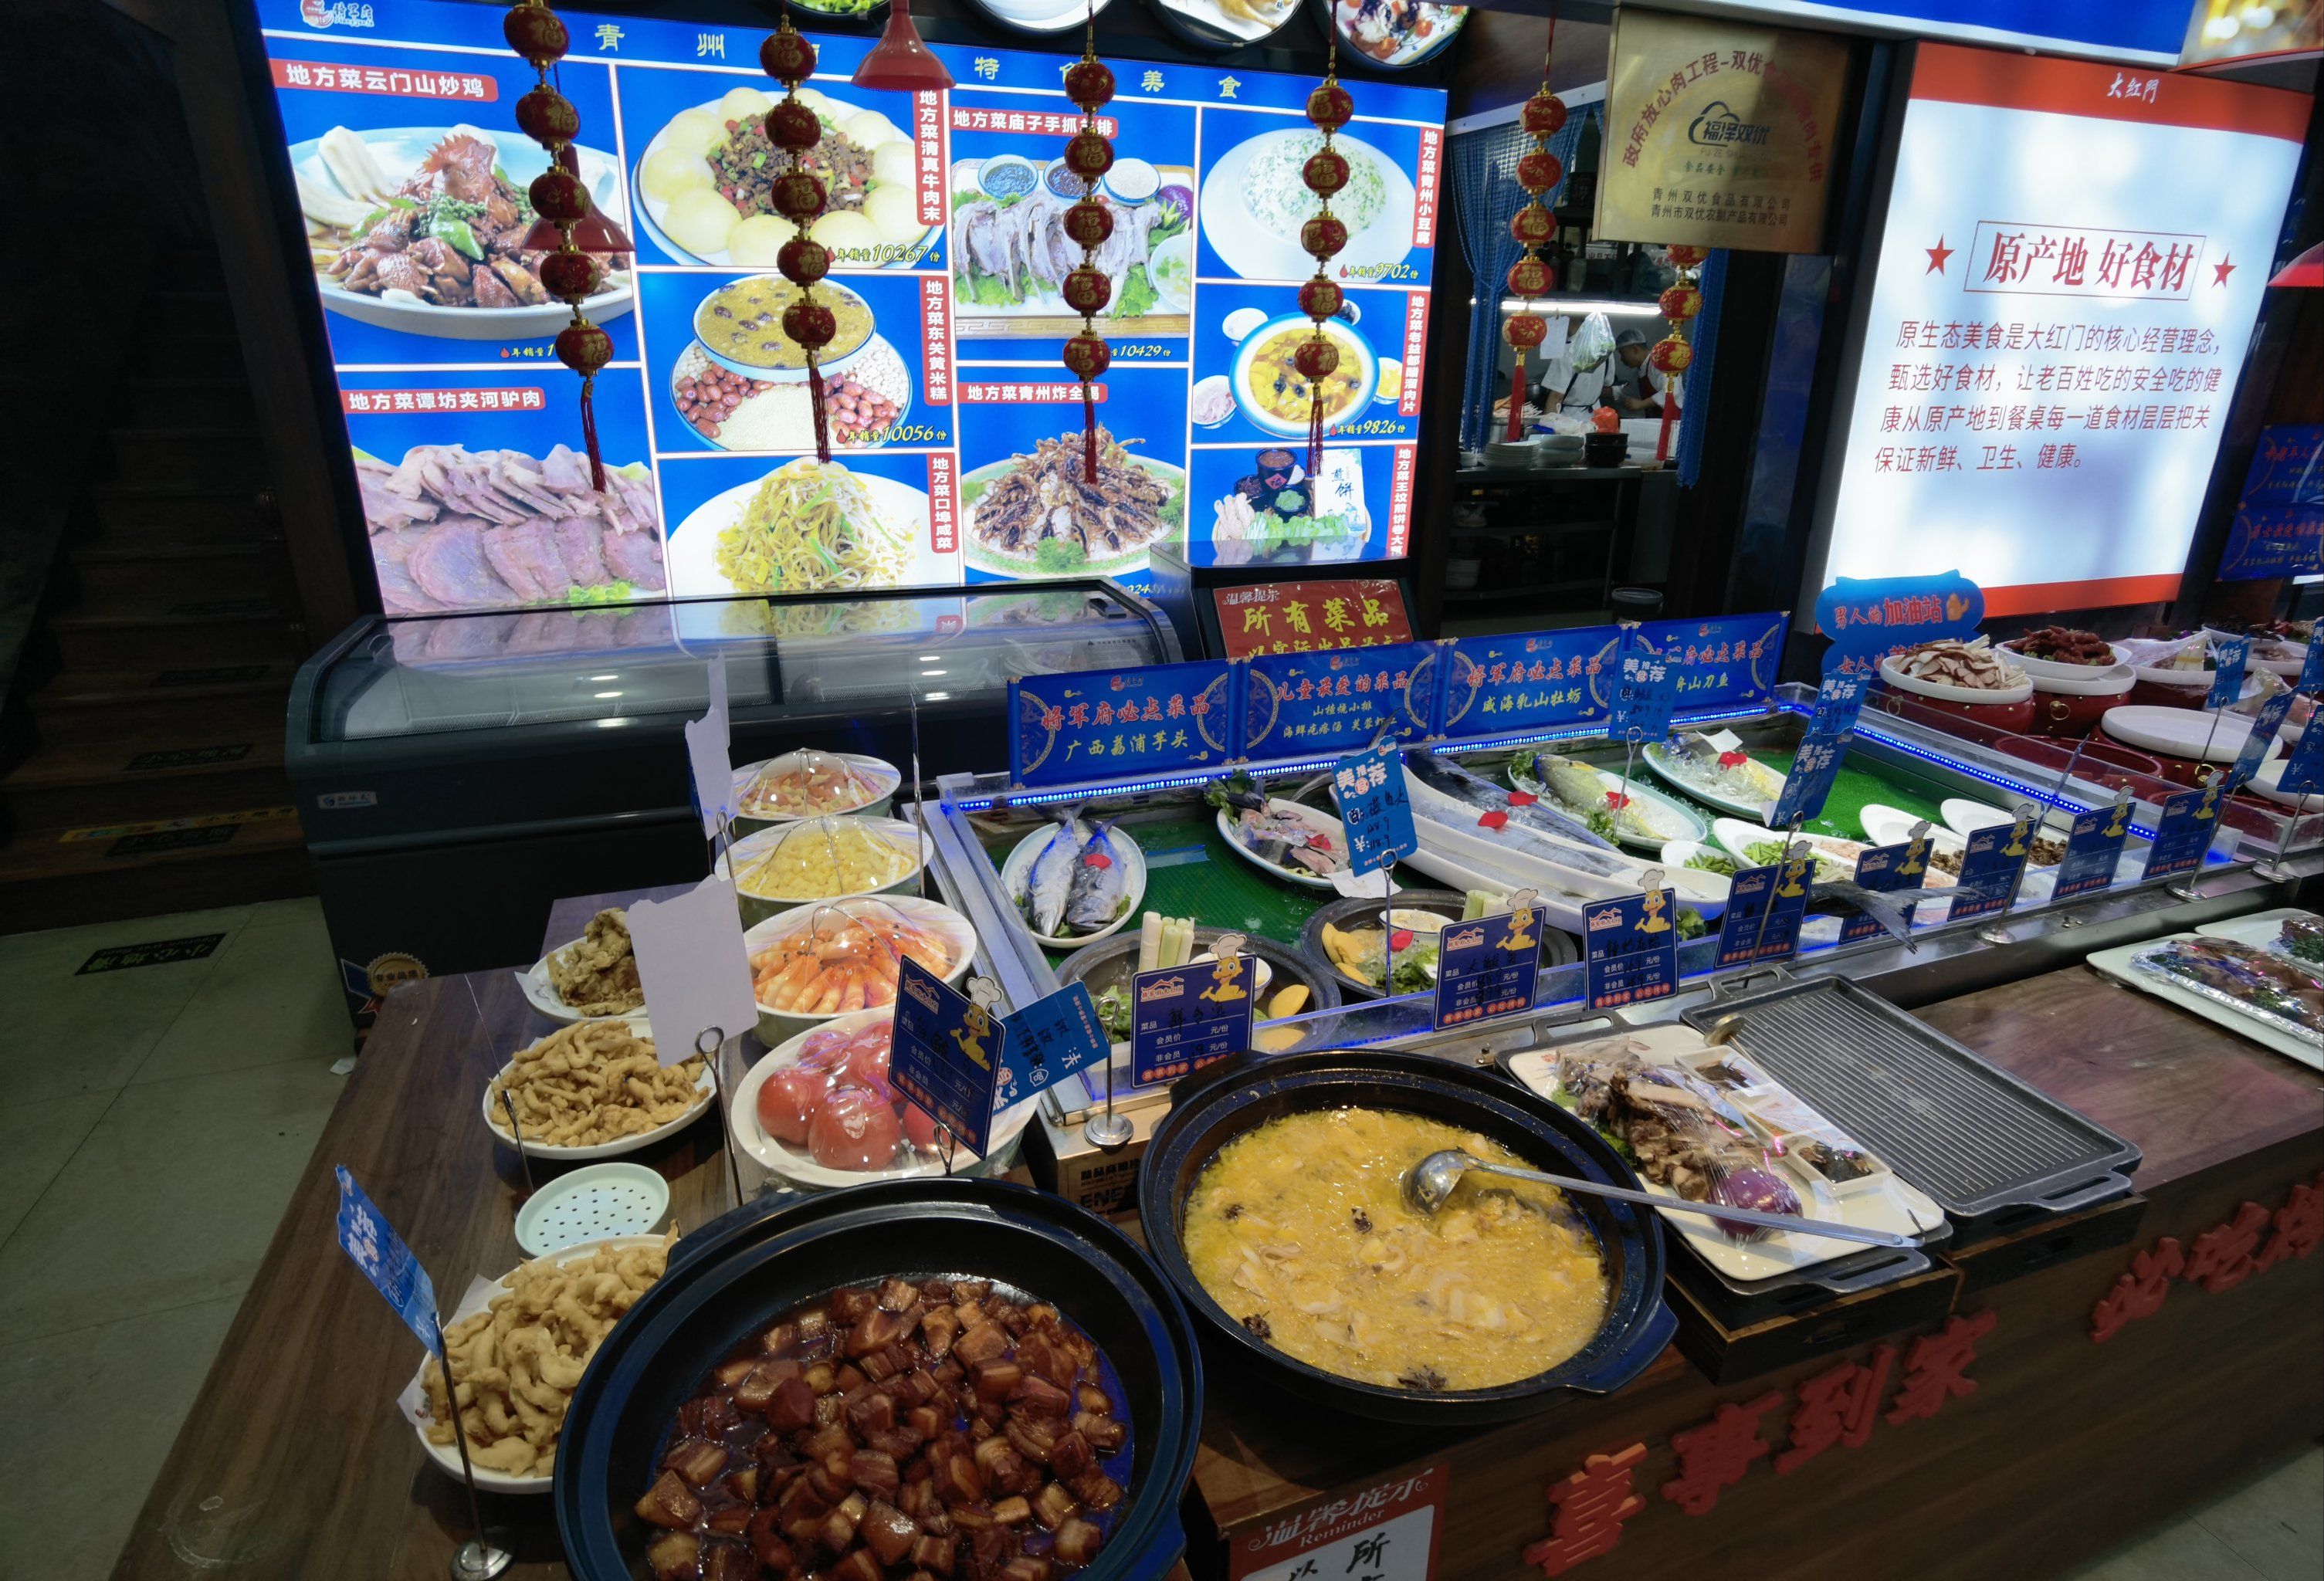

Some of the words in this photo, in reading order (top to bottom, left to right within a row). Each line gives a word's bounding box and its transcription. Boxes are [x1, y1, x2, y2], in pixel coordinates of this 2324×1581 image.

[286, 63, 484, 98] 地方菜云门山炒鸡
[1702, 120, 1770, 146] 福泽双优
[919, 90, 940, 221] 地方菜清真牛肉末
[1415, 130, 1438, 244] 地方菜青州小豆腐
[1652, 187, 1791, 212] 青州双优食品有限公司
[1651, 203, 1789, 227] 青州市双优农副产品有限公司
[1983, 232, 2089, 286] 原产地
[2095, 237, 2196, 293] 好食材
[926, 280, 948, 400] 地方菜东关黄米糕
[349, 391, 541, 411] 地方菜谭坊夹河驴肉
[1879, 405, 2211, 433] 康从原产地到餐桌每一道食材层层把关
[932, 457, 954, 549] 地方菜口埠咸菜
[1222, 590, 1279, 605] 温馨提示
[1243, 598, 1389, 637] 所有菜品
[1834, 595, 1943, 630] 男人的加油站
[1467, 654, 1603, 688] 将军府必点菜品
[1676, 672, 1729, 693] 舟山刀鱼
[1275, 670, 1408, 702] 儿童最爱的菜品
[1041, 693, 1211, 731] 将军府必点菜品
[1313, 700, 1373, 716] 山楂烧小排
[1482, 687, 1582, 714] 威海乳山牡蛎
[1064, 729, 1189, 763] 广西荔浦芋头
[1591, 950, 1604, 959] 菜品
[1445, 968, 1459, 977] 菜品
[1604, 963, 1623, 973] 会员价
[1457, 980, 1478, 990] 会员价
[1604, 980, 1624, 990] 非会员
[1456, 996, 1476, 1007] 非会员
[1140, 1021, 1157, 1031] 菜品
[1157, 1033, 1181, 1044] 会员价
[911, 1045, 932, 1066] 会员价
[1155, 1051, 1181, 1062] 非会员
[909, 1065, 928, 1086] 非会员
[1300, 1508, 1386, 1549] Reminder
